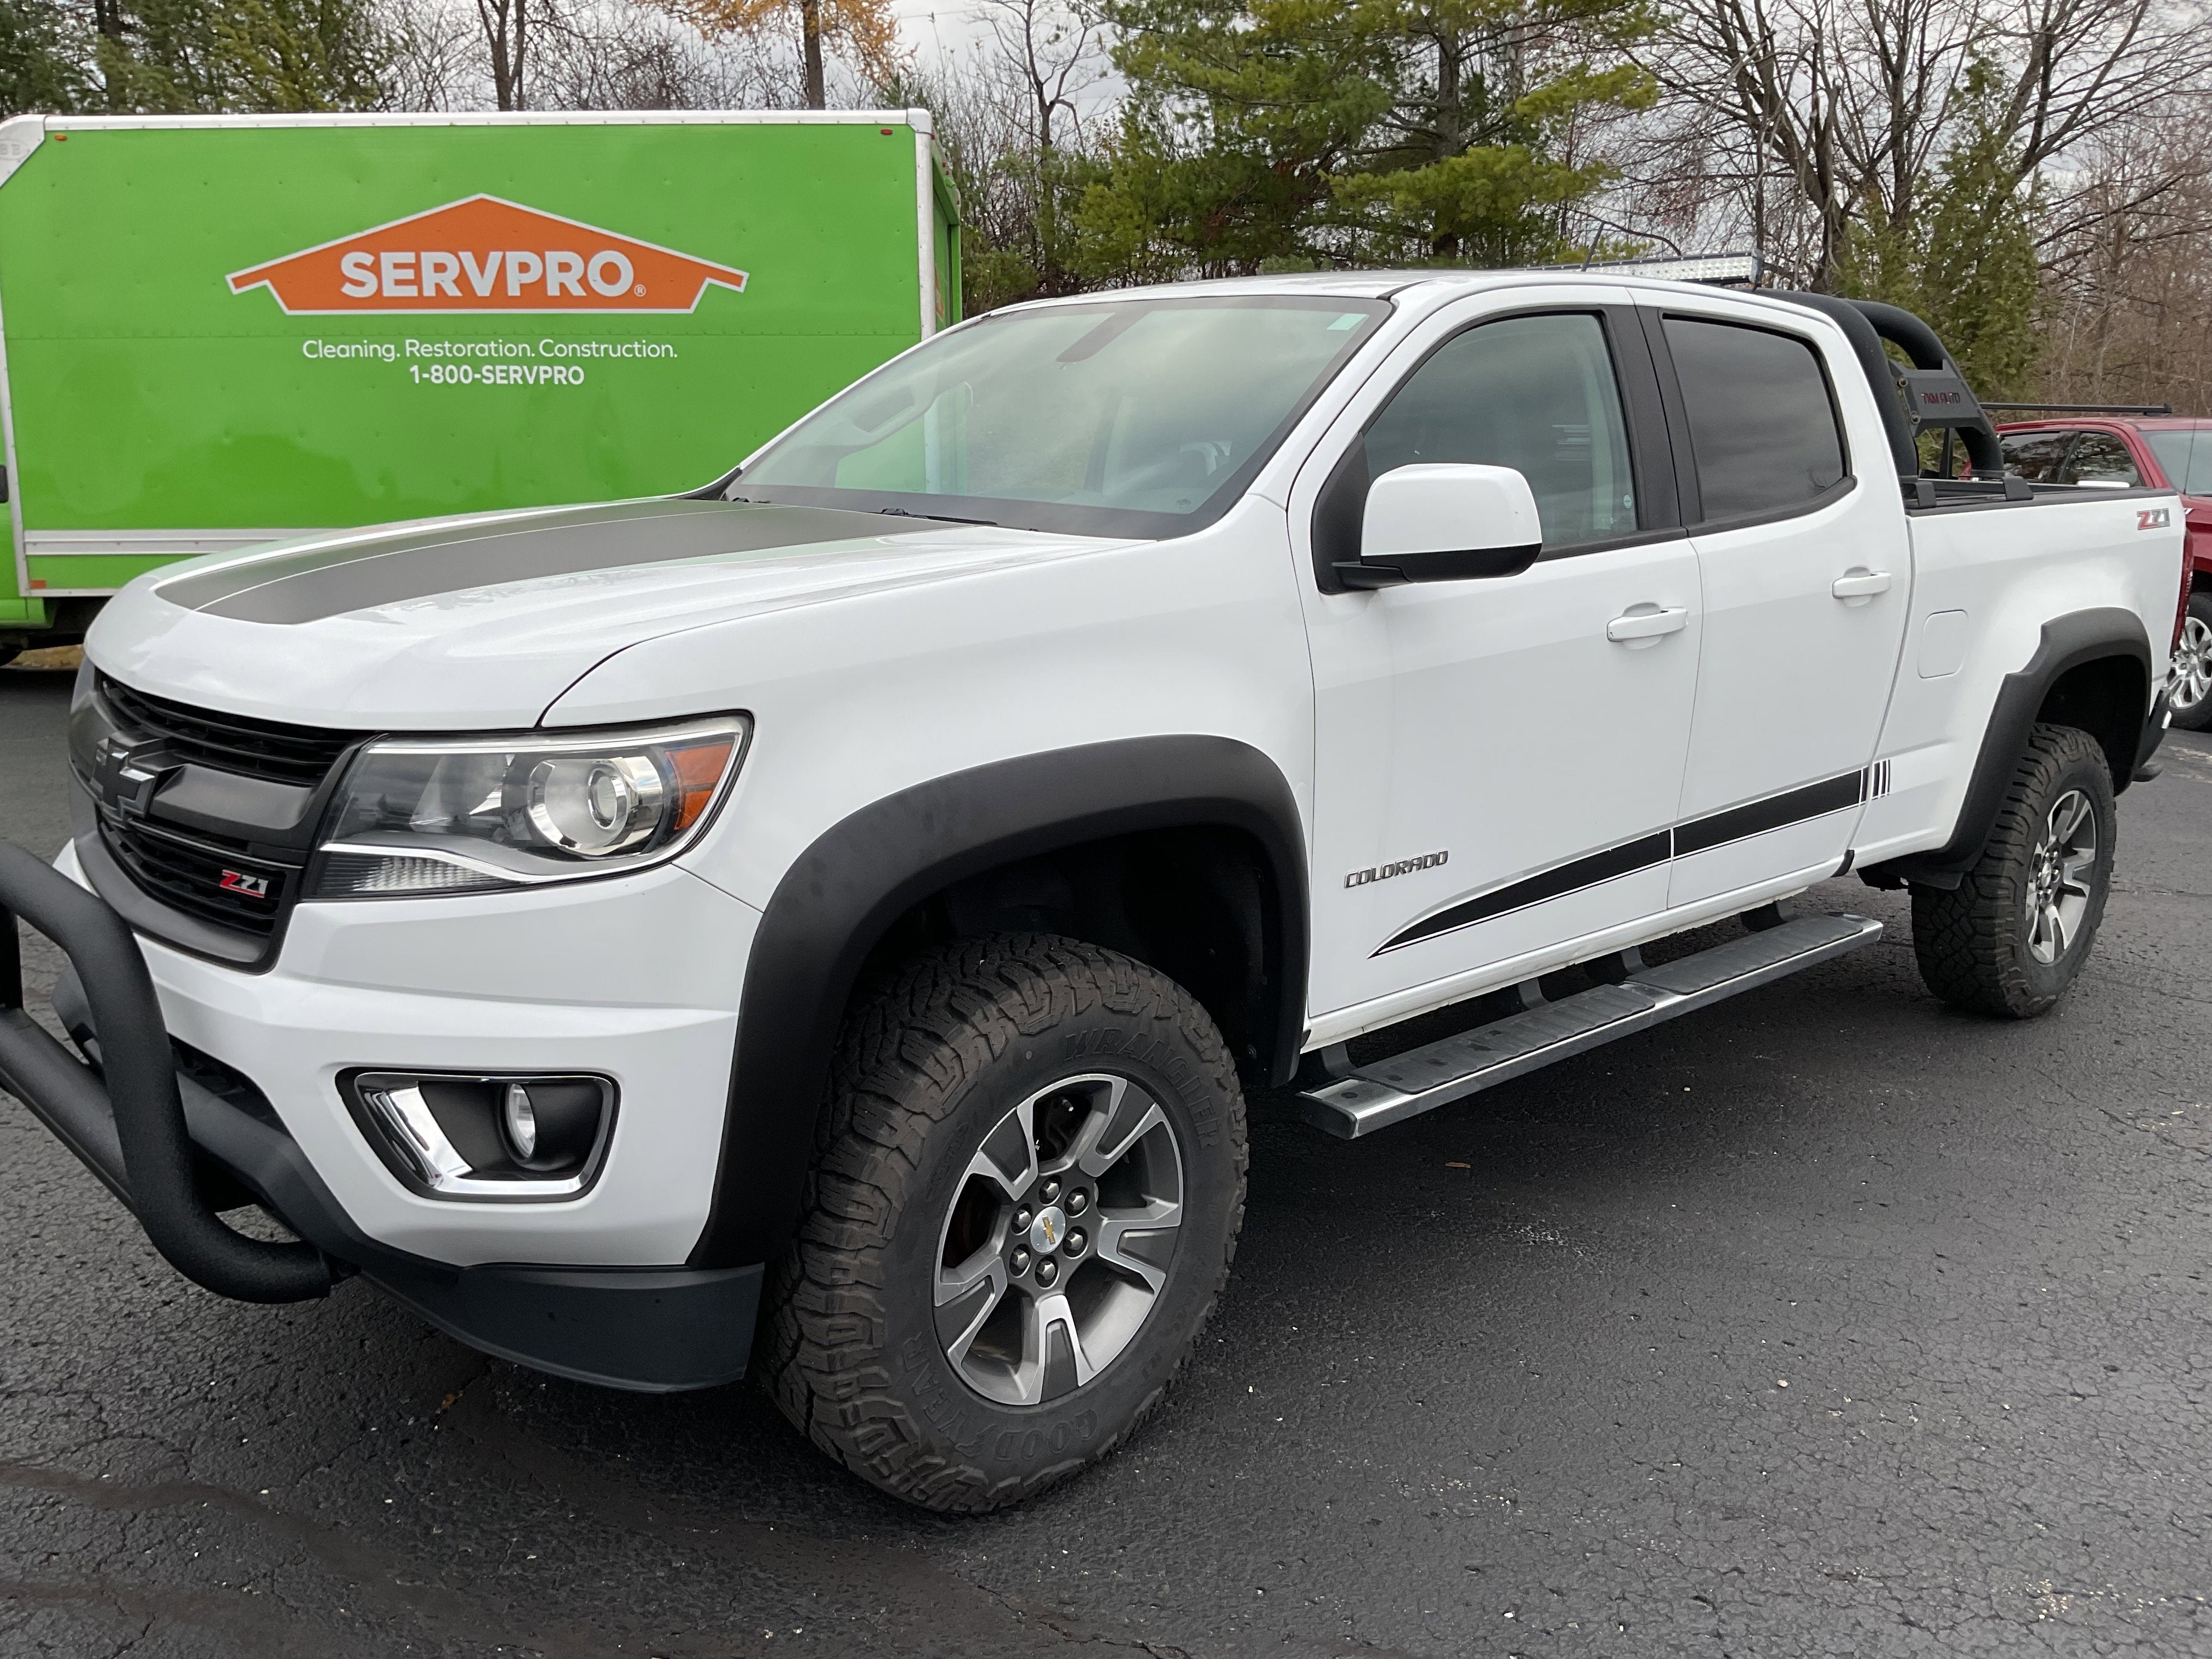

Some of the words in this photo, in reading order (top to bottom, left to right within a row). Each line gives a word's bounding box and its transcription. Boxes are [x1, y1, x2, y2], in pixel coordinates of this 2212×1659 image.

[340, 250, 634, 297] SERVPRO
[302, 339, 400, 362] Cleaning.
[405, 339, 535, 357] Restoration.
[539, 339, 678, 357] Construction.
[409, 365, 584, 385] 1-800-SERVPRO
[2137, 508, 2170, 531] Z71
[219, 869, 269, 898] Z71
[1344, 850, 1448, 888] COLORADO
[1064, 1026, 1220, 1150] WRANGLER
[902, 1330, 1099, 1462] GOODYEAR
